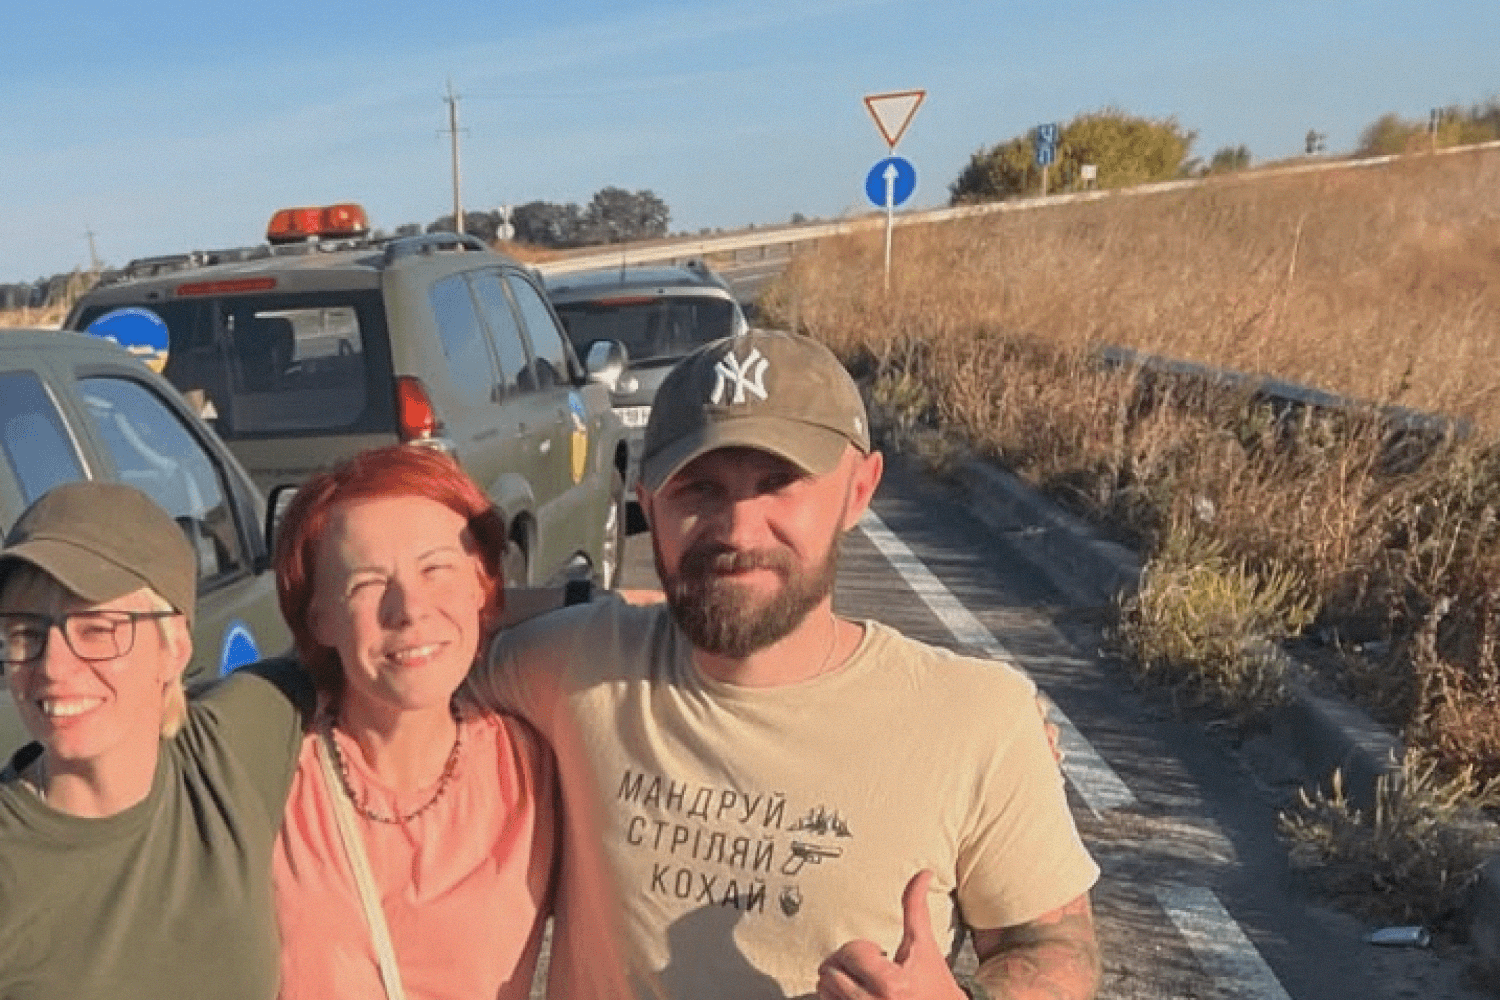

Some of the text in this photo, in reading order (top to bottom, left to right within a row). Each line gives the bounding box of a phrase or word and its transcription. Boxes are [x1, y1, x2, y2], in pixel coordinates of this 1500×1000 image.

[711, 347, 769, 404] NY
[618, 769, 786, 829] МАНДРУЙ
[626, 815, 775, 872] СТРІЛЯЙ
[651, 863, 767, 913] КОХАЙ
